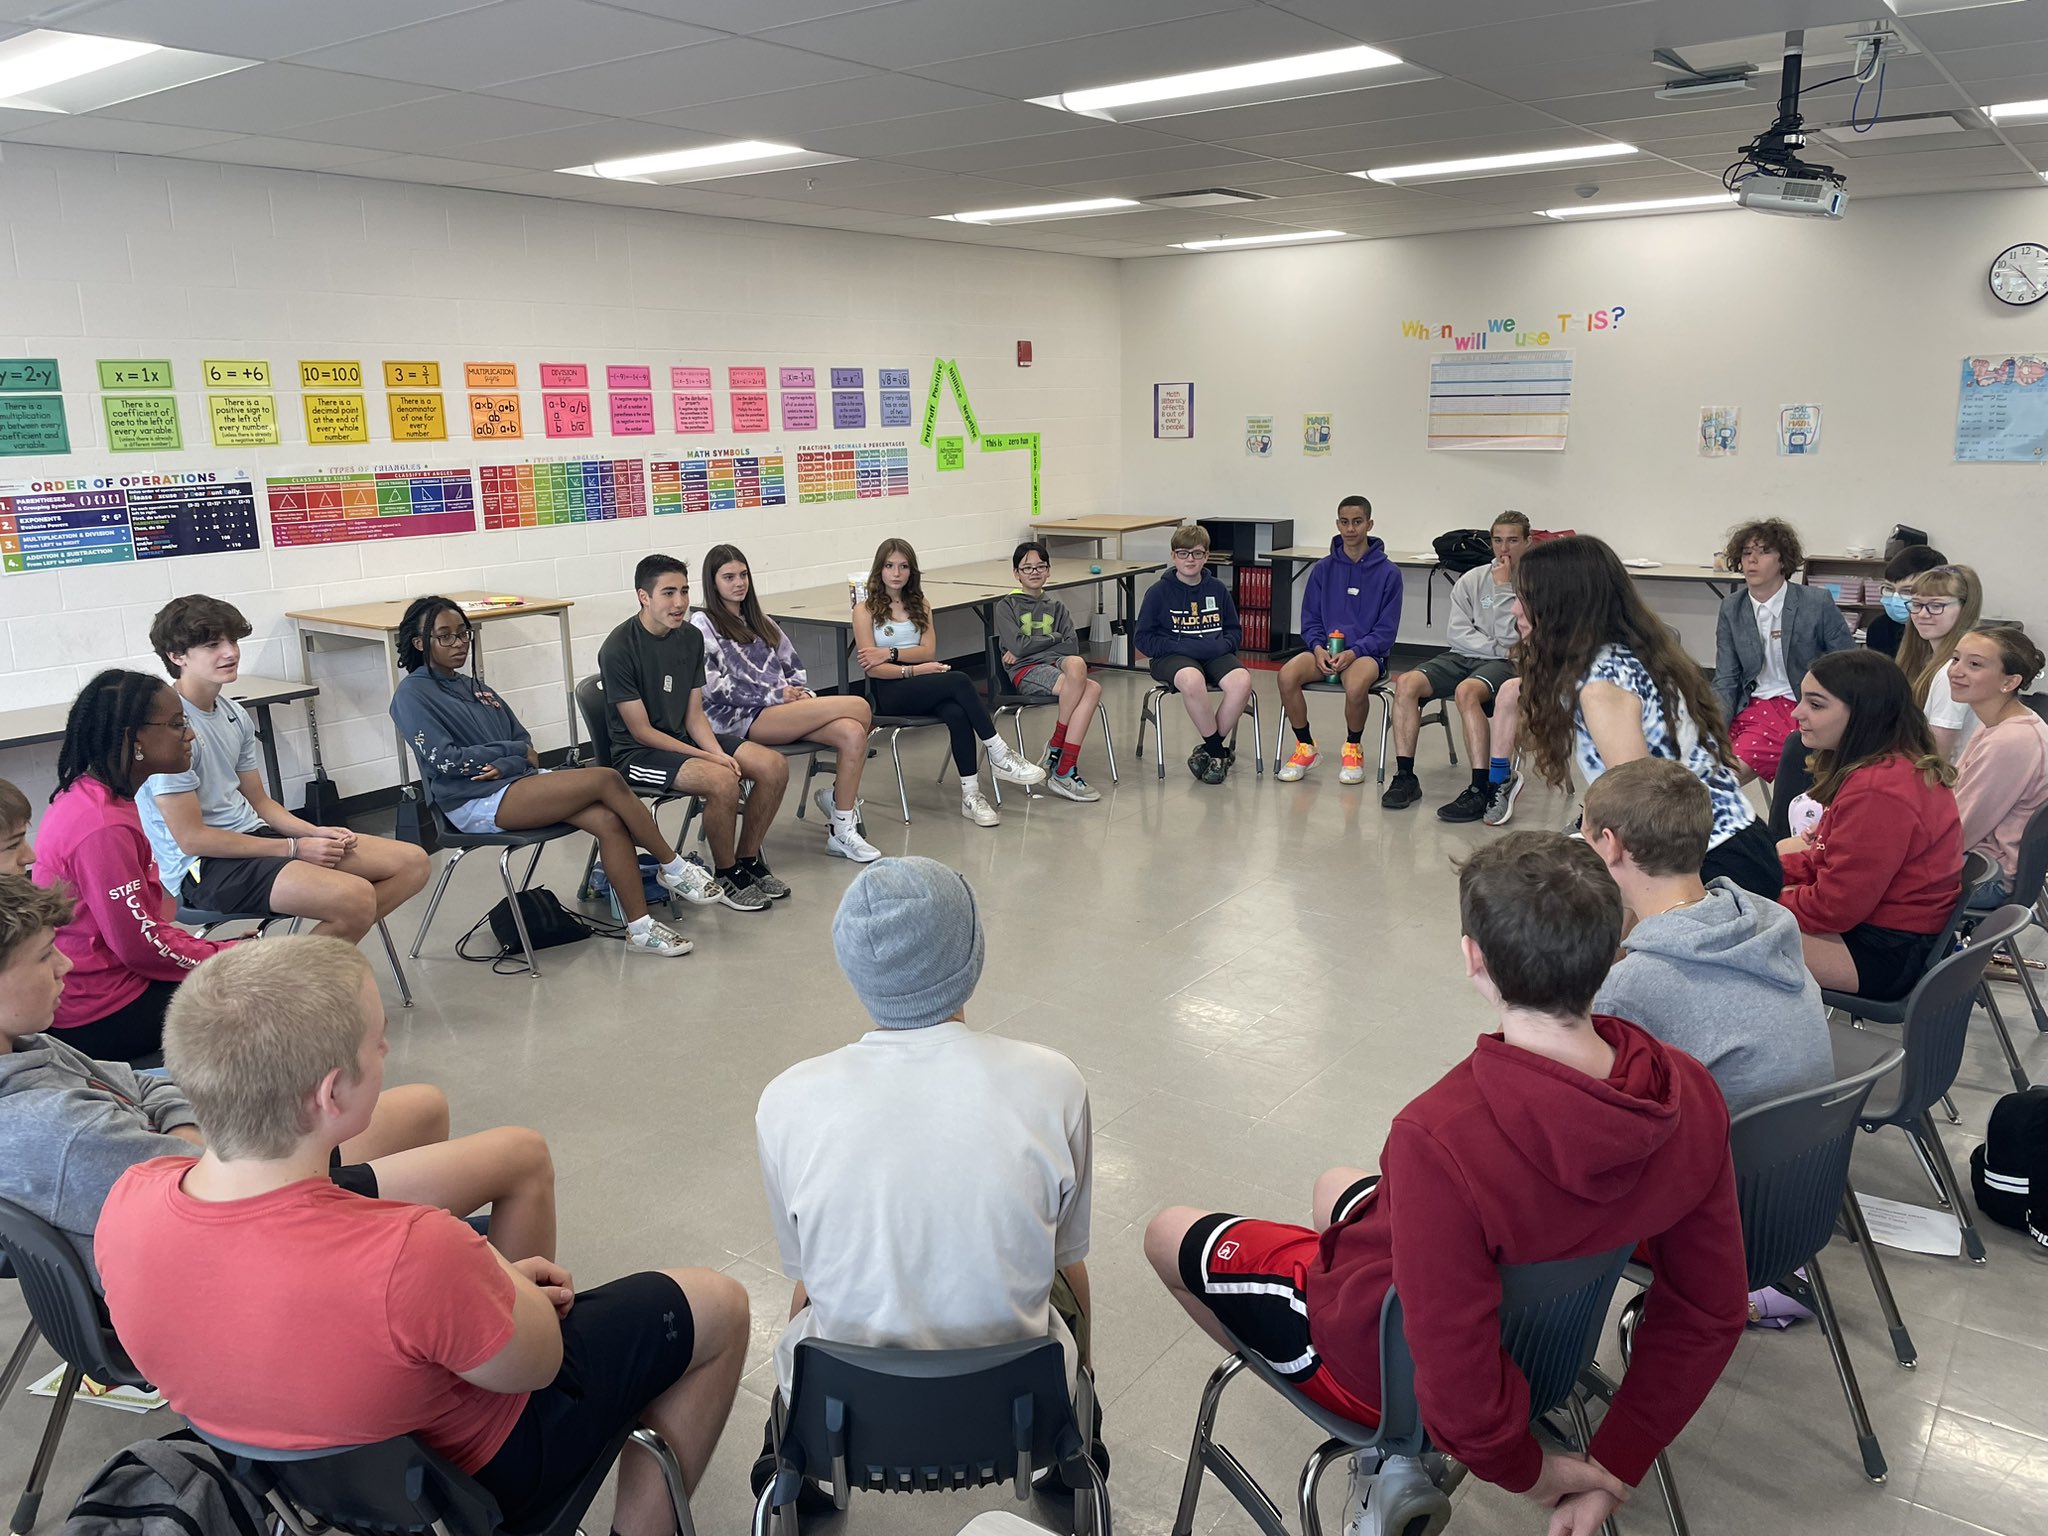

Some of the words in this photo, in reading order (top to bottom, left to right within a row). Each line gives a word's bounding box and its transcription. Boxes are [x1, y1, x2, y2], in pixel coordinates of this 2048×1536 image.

[1998, 260, 2006, 268] 10
[1401, 319, 1452, 340] When
[1455, 332, 1486, 351] will
[1488, 318, 1516, 332] we
[1514, 332, 1550, 346] use
[1558, 306, 1625, 332] TIS?
[142, 367, 160, 382] 1x
[210, 366, 222, 381] 6
[242, 364, 264, 381] +6
[394, 368, 404, 382] 3
[932, 364, 942, 398] Positive
[4, 402, 26, 410] There
[121, 400, 143, 408] There
[224, 398, 244, 406] There
[318, 398, 337, 406] There
[570, 400, 586, 414] a/b
[112, 408, 158, 418] coefficient
[160, 408, 170, 416] of
[216, 408, 244, 416] positive
[246, 408, 260, 416] sign
[312, 406, 340, 414] decimal
[342, 406, 358, 416] point
[488, 410, 500, 422] ab
[136, 418, 148, 426] the
[150, 416, 162, 425] left
[165, 416, 174, 425] of
[253, 414, 262, 422] of
[963, 404, 977, 438] Negative
[8, 422, 39, 430] between
[140, 426, 174, 434] variable.
[476, 422, 495, 436] a(b)
[998, 439, 1002, 447] is
[713, 448, 750, 457] SYMBOLS
[32, 480, 87, 492] ORDER
[94, 478, 113, 489] OF
[120, 472, 216, 487] OPERATIONS
[16, 496, 66, 504] PARENTHESES
[2, 522, 12, 530] 2.
[5, 541, 16, 549] 3.
[23, 532, 78, 542] MULTIPLICATION
[66, 548, 113, 557] SUBTRACTION
[109, 880, 141, 900] STAE
